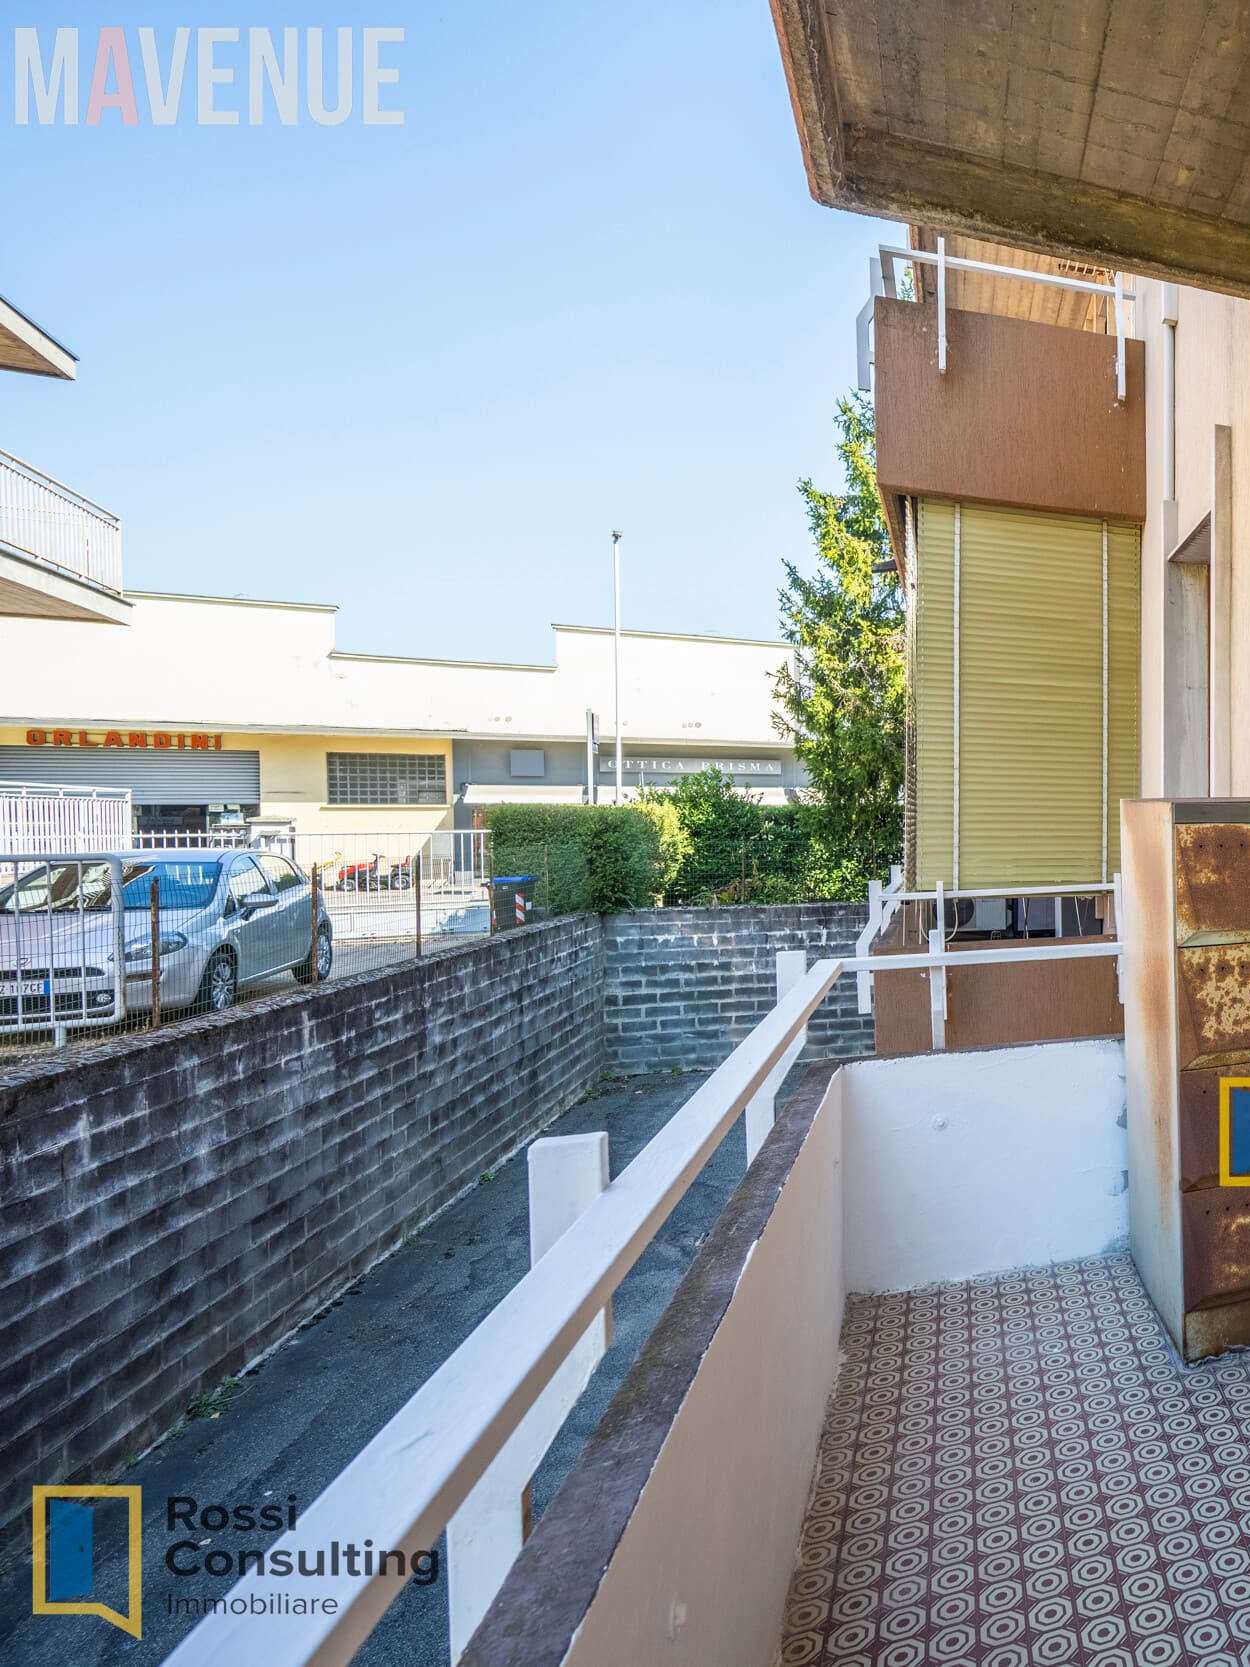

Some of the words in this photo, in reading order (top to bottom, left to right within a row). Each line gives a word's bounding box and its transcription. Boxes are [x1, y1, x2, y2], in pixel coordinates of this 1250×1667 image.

[26, 729, 223, 750] ORLANDINI
[608, 759, 685, 770] OTTICA
[701, 761, 775, 772] PRISMA
